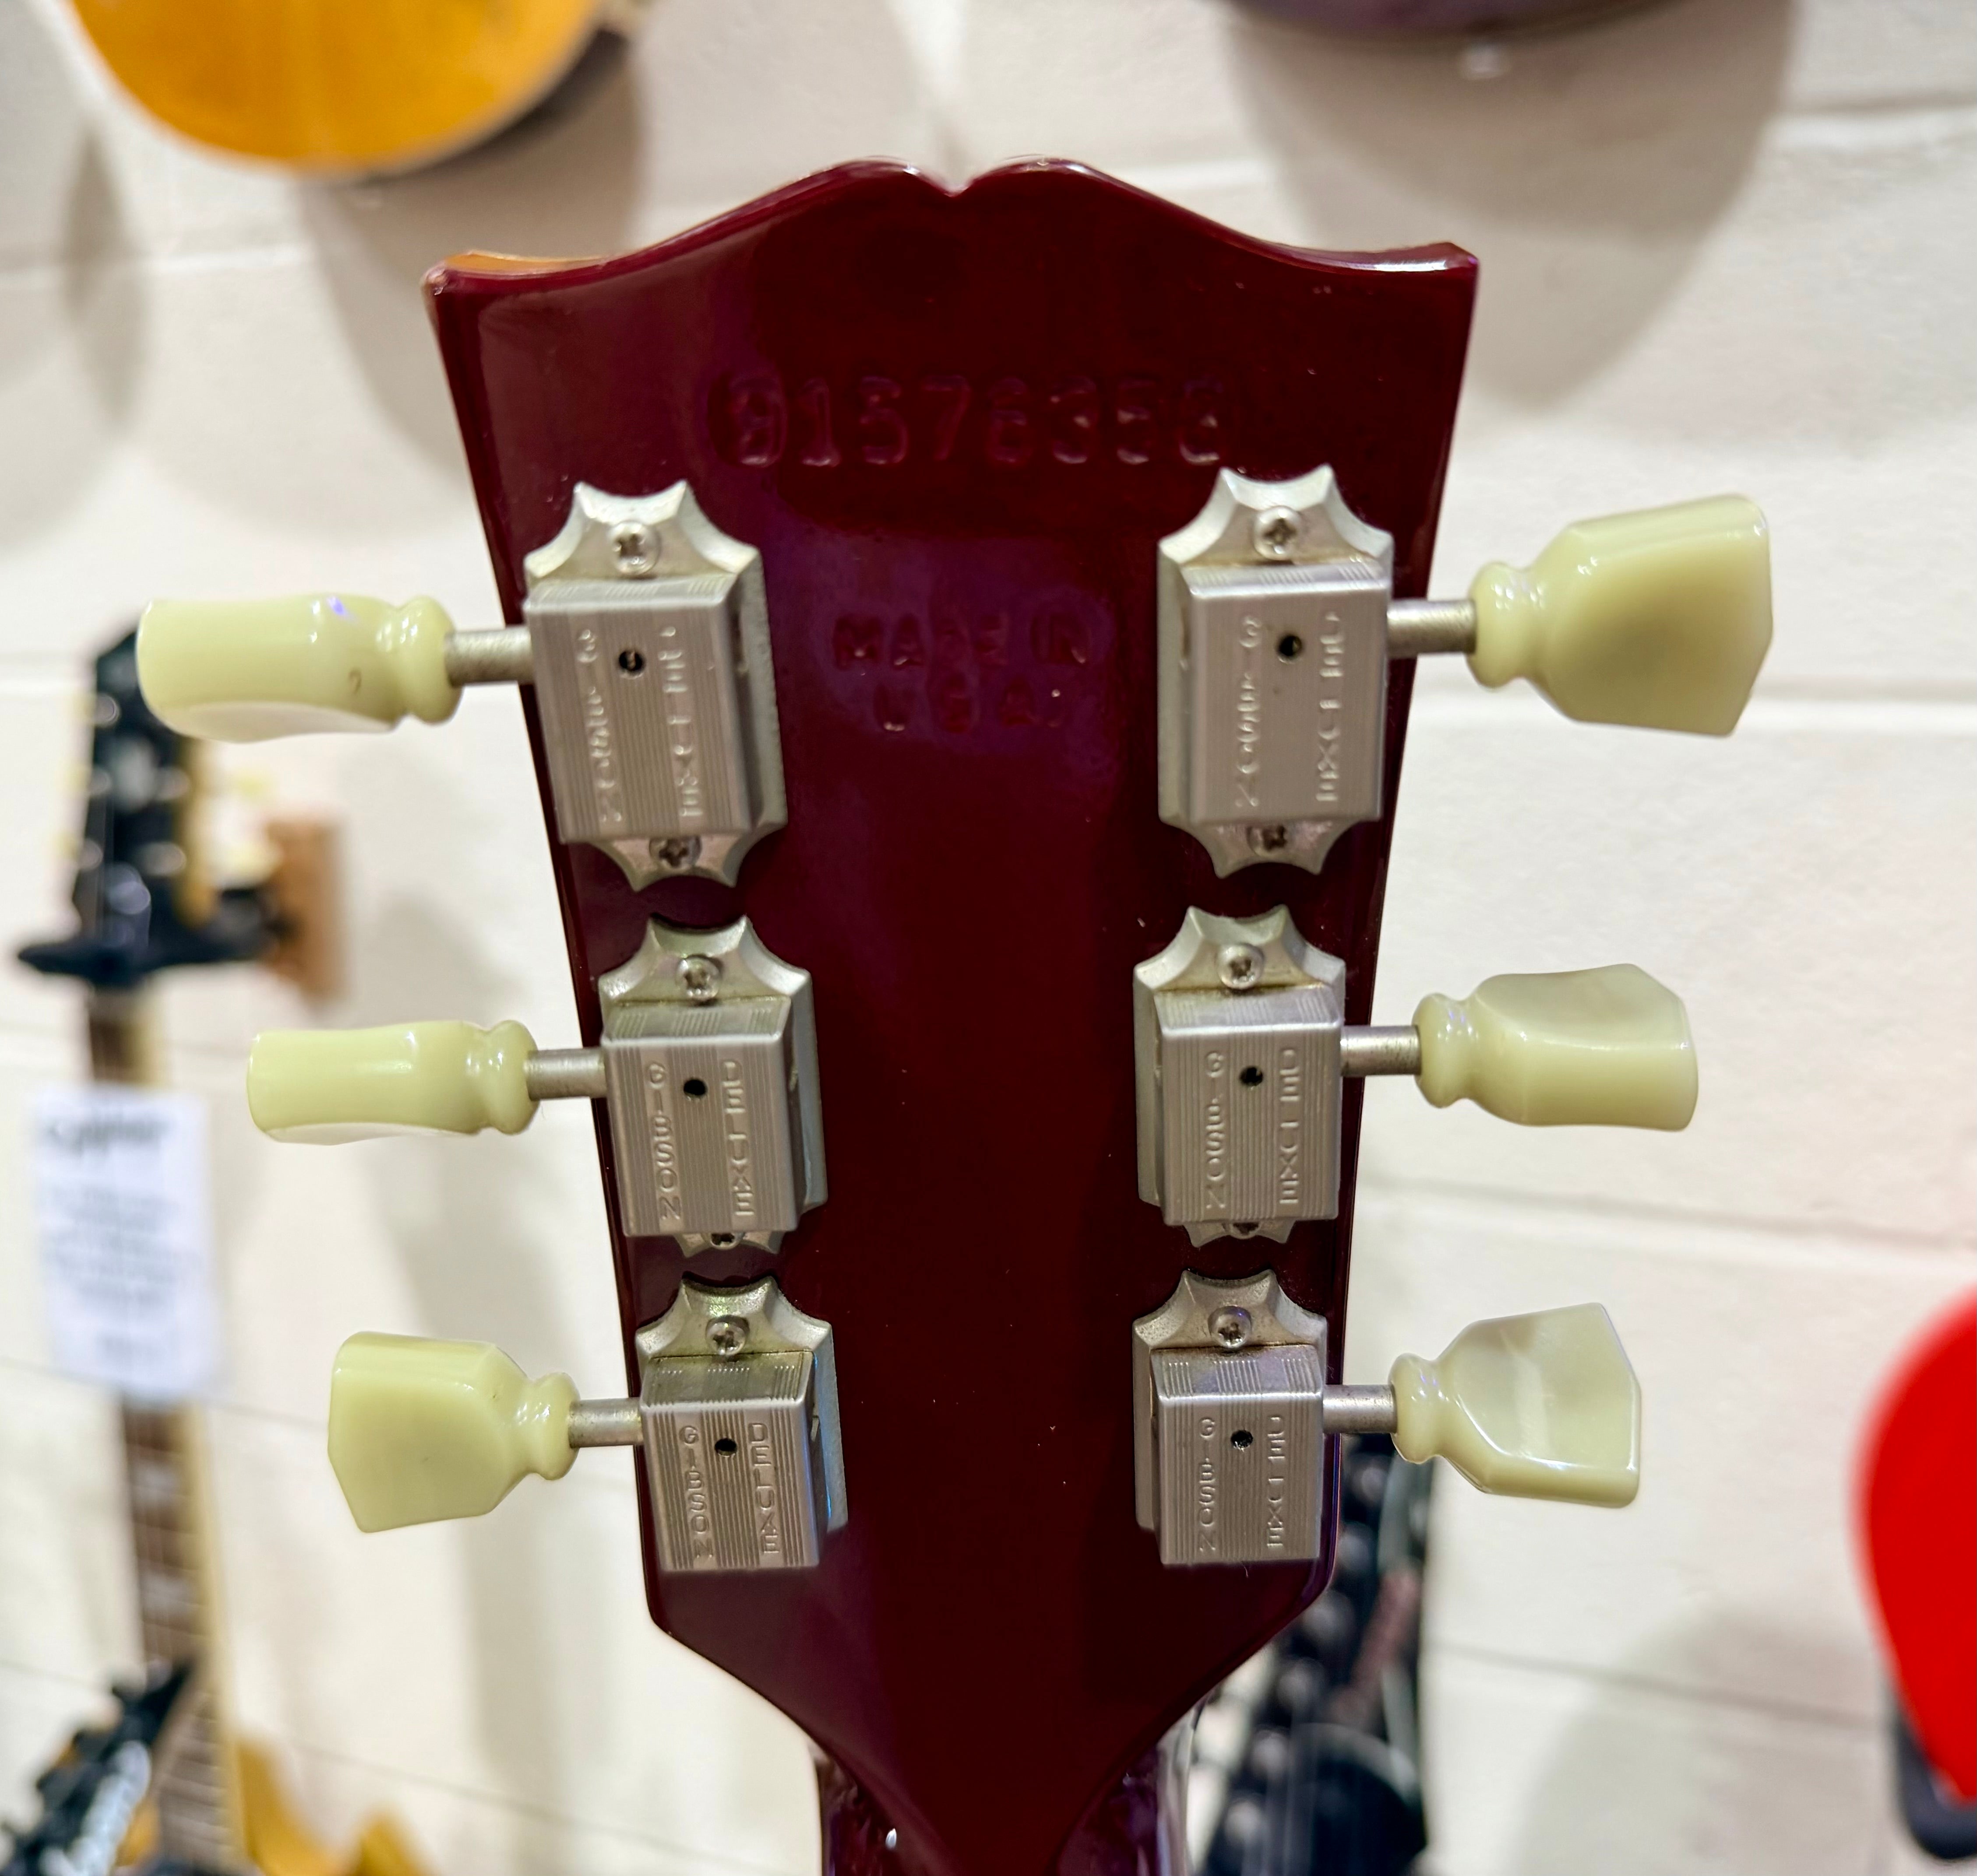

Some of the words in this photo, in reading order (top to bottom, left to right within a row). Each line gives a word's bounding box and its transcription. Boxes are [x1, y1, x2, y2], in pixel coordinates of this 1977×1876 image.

[647, 1062, 683, 1221] GIBSON
[721, 1059, 755, 1217] DELUXE
[1205, 1051, 1226, 1210] GIBSON
[1278, 1047, 1300, 1205] DELUXE
[678, 1424, 714, 1559] GIBSON
[747, 1421, 780, 1555] DELUXE
[1198, 1417, 1217, 1553] GIBSON
[1266, 1415, 1286, 1548] DELUXE
